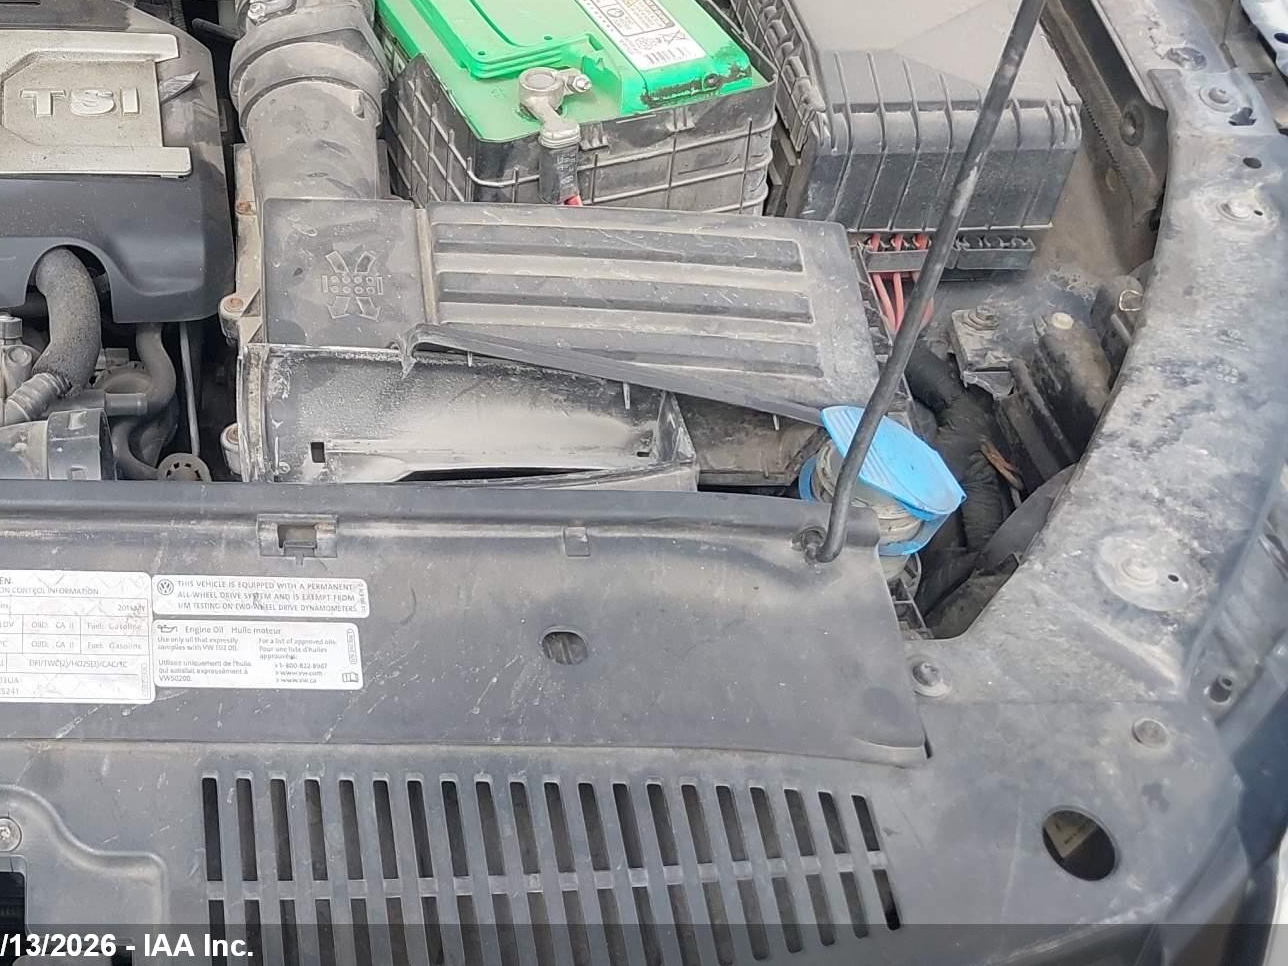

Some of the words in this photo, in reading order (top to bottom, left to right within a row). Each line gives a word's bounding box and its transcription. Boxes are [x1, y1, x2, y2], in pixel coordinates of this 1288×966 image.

[19, 86, 140, 117] TSI
[196, 580, 226, 588] VEHICLE
[307, 583, 353, 591] PERMANENT
[220, 591, 242, 599] DRIVE
[302, 593, 330, 601] EXEMPT
[185, 625, 211, 635] Engine
[212, 625, 224, 634] Oil
